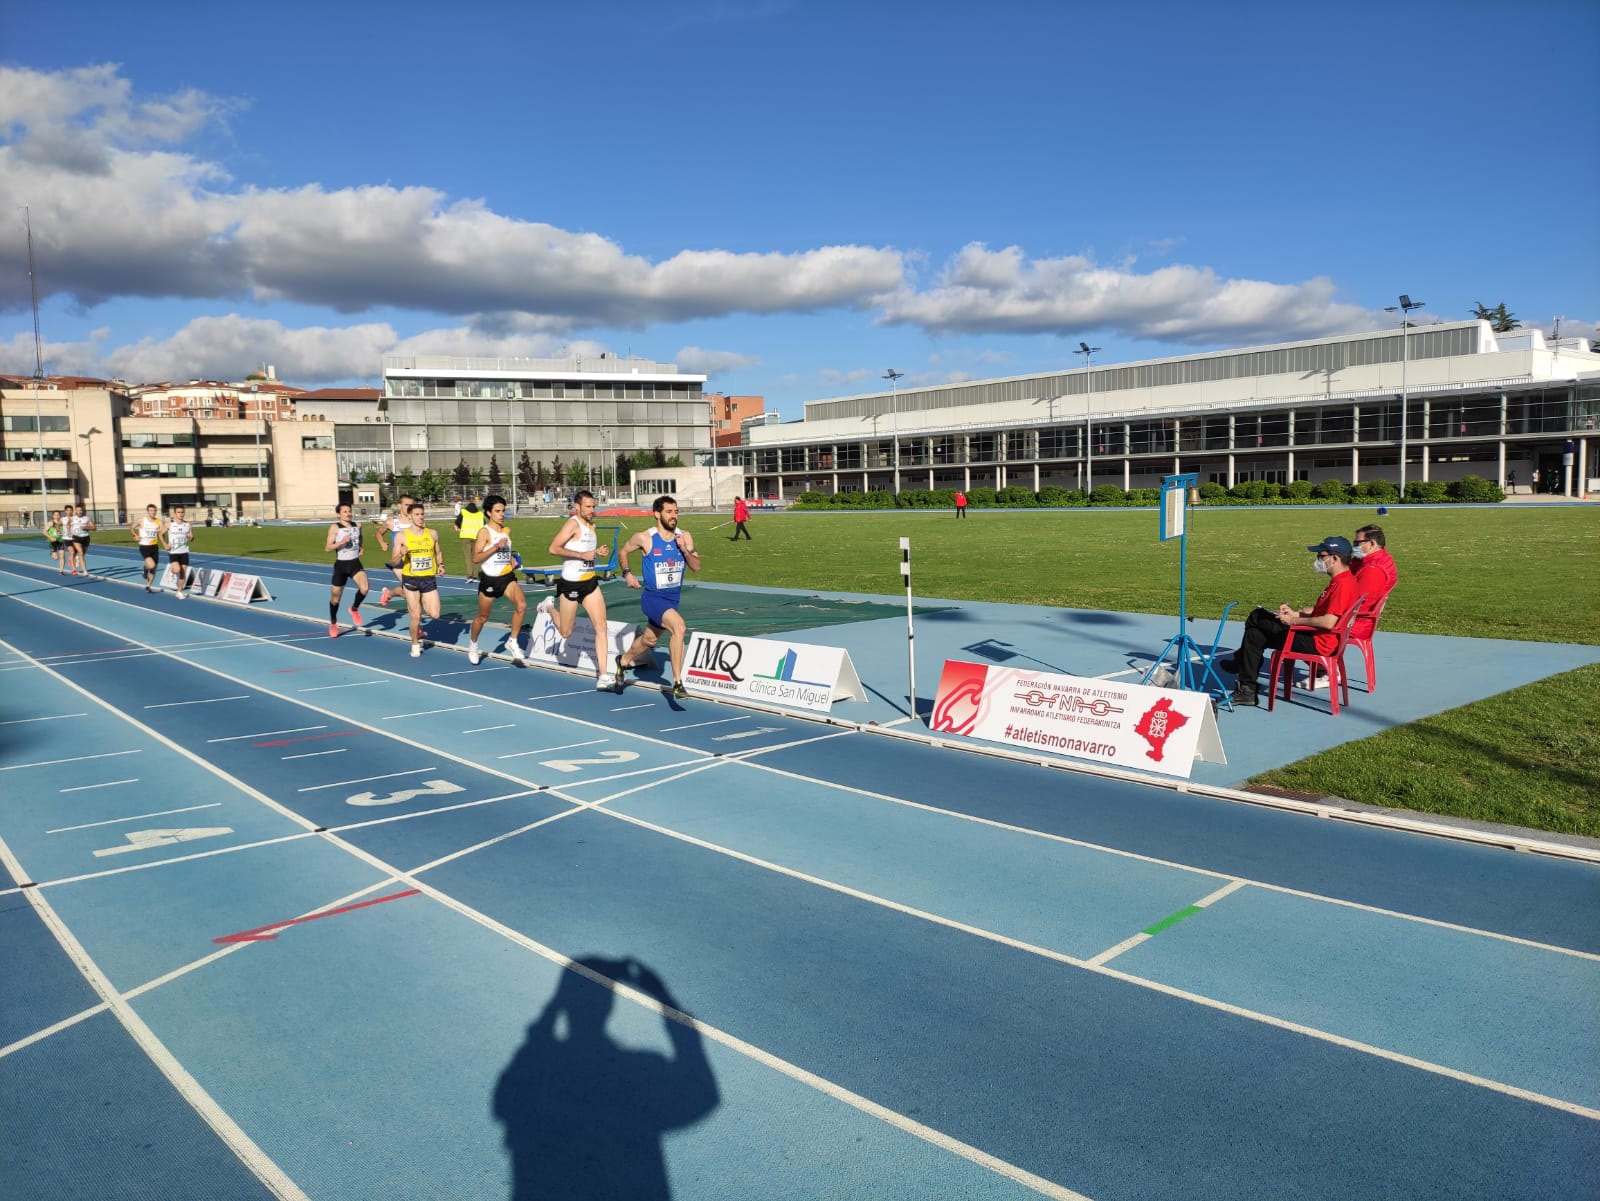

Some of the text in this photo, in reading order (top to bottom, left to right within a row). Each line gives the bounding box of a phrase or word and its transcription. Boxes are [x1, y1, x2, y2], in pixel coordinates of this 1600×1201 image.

[667, 574, 673, 582] 6
[689, 637, 744, 682] IMQ
[778, 684, 795, 699] San
[796, 688, 830, 706] Miguel
[1016, 679, 1128, 701] FEDERACIÓN NAVARRA DE ATLETISMO
[1045, 711, 1076, 723] ATLETISMO
[1077, 715, 1121, 730] FEDERAKUNTZA
[1004, 724, 1117, 757] #atletismonavarro
[538, 751, 640, 773] 2
[345, 779, 467, 806] 3
[92, 827, 235, 857] 4
